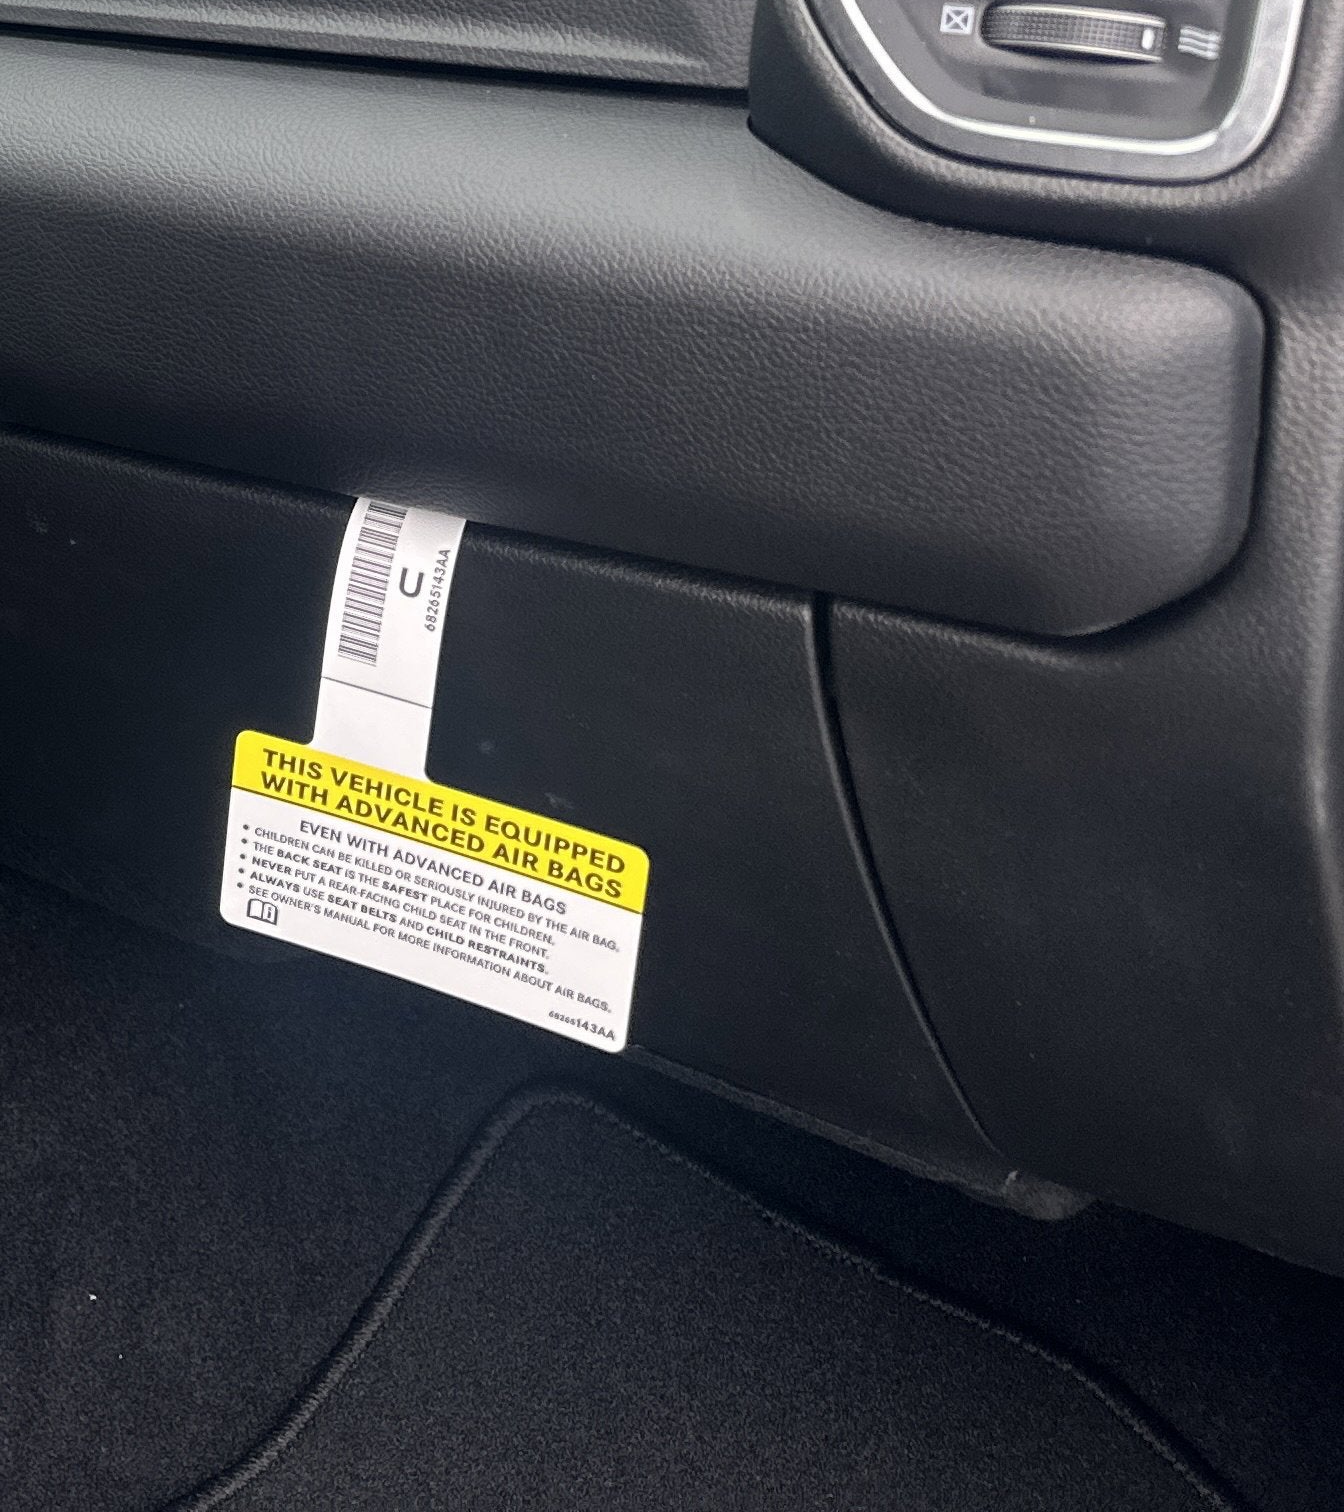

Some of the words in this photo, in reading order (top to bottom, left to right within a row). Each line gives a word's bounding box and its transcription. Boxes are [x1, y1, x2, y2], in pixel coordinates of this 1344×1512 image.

[399, 567, 424, 598] U
[424, 549, 451, 633] 68265143AA
[260, 770, 329, 807] WITH
[334, 794, 485, 853] ADVANCED
[491, 842, 539, 873] AIR
[547, 858, 622, 899] BAGS
[262, 747, 323, 781] THIS
[330, 766, 444, 818] VEHICLE
[451, 803, 477, 827] IS
[484, 814, 626, 874] EQUIPPED
[249, 871, 301, 893] ALWAYS
[302, 886, 325, 901] USE
[326, 894, 359, 911] SEAT
[360, 904, 398, 923] BELTS
[398, 916, 425, 932] AND
[426, 925, 466, 945] CHILD
[251, 855, 292, 876] NEVER
[294, 868, 317, 883] PUT
[317, 875, 327, 887] A
[328, 878, 401, 909] REAR-FACING
[402, 902, 438, 921] CHILD
[439, 914, 468, 931] SEAT
[468, 923, 483, 937] IN
[484, 928, 507, 945] THE
[252, 841, 275, 856] THE
[276, 848, 311, 867] BACK
[312, 859, 344, 876] SEAT
[344, 868, 356, 880] IS
[357, 872, 380, 888] THE
[381, 880, 428, 903] SAFEST
[430, 895, 467, 916] PLACE
[468, 907, 492, 925] FOR
[254, 827, 310, 851] CHILDREN
[311, 843, 336, 859] CAN
[337, 851, 353, 864] BE
[354, 856, 394, 876] KILLED
[394, 869, 412, 883] OR
[413, 875, 476, 903] SERIOUSLY
[477, 895, 526, 919] INJURED
[527, 912, 544, 925] BY
[545, 917, 568, 935] THE
[569, 927, 591, 942] AIR
[299, 819, 342, 844] EVEN
[346, 833, 390, 858] WITH
[392, 849, 484, 887] ADVANCED
[487, 879, 517, 899] AIR
[521, 889, 567, 915] BAGS
[248, 884, 270, 899] SEE
[323, 907, 371, 931] MANUAL
[372, 922, 396, 938] FOR
[397, 931, 431, 950] MORE
[432, 942, 512, 978] INFORMATION
[512, 970, 554, 992] ABOUT
[554, 984, 575, 1000] AIR
